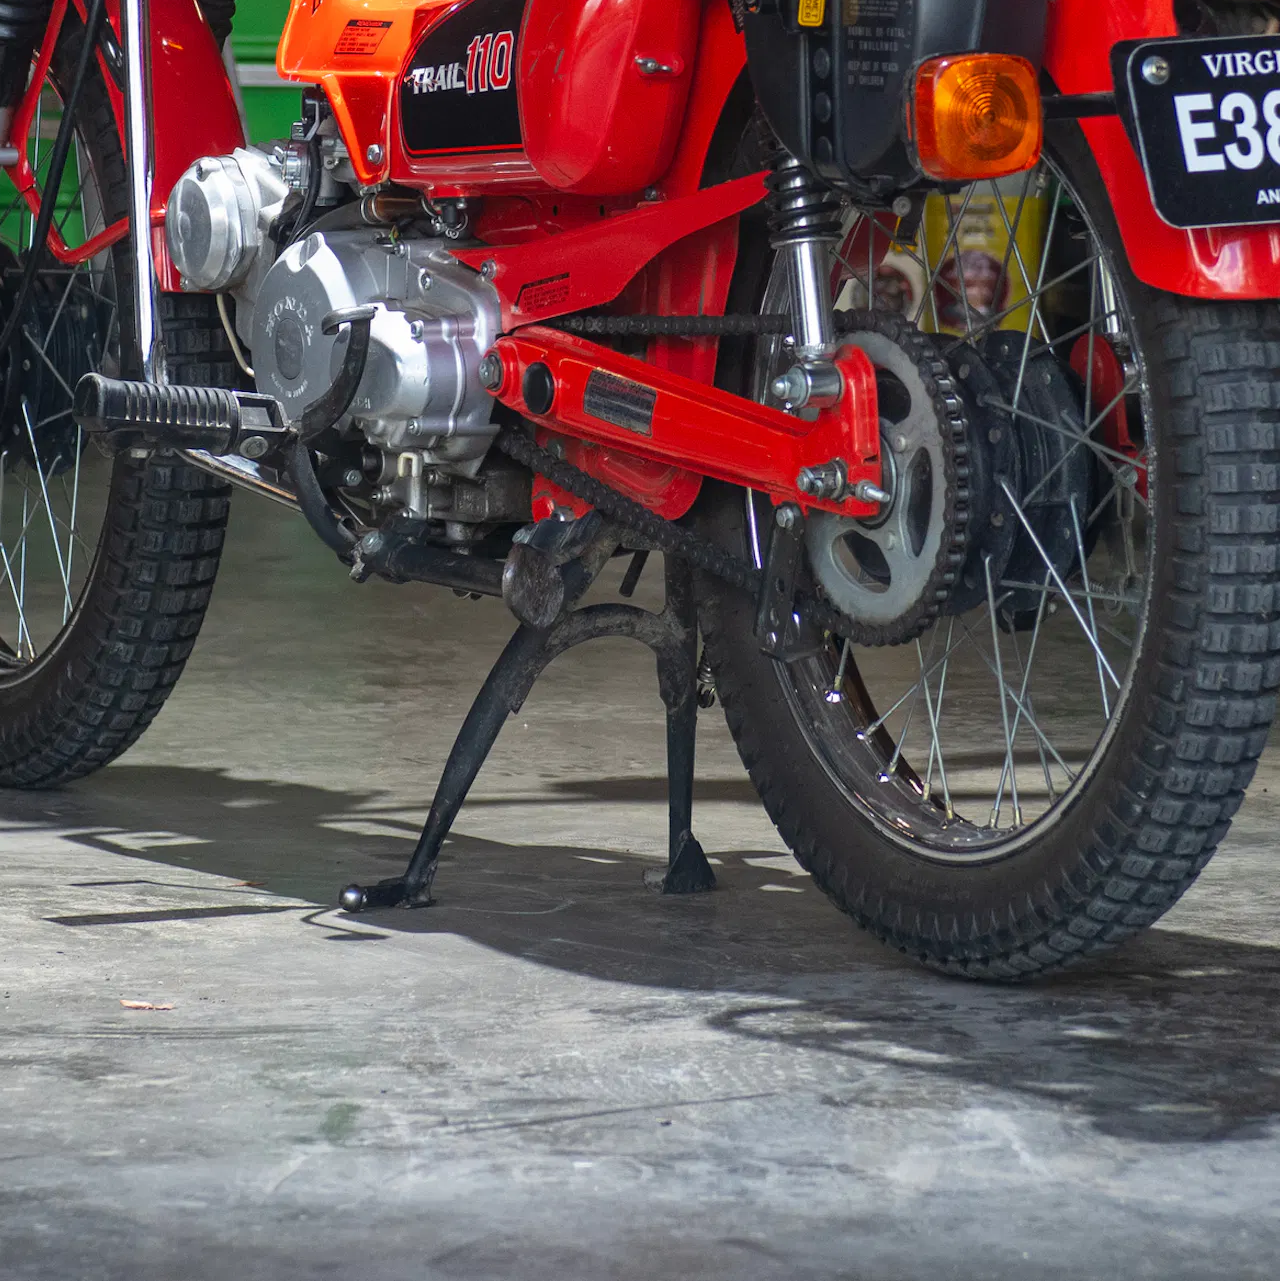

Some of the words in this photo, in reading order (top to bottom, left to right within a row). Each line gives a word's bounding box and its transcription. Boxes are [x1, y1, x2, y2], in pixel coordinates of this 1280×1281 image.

[412, 65, 465, 95] TRAIL
[466, 30, 515, 94] 110
[266, 296, 314, 346] HONDA
